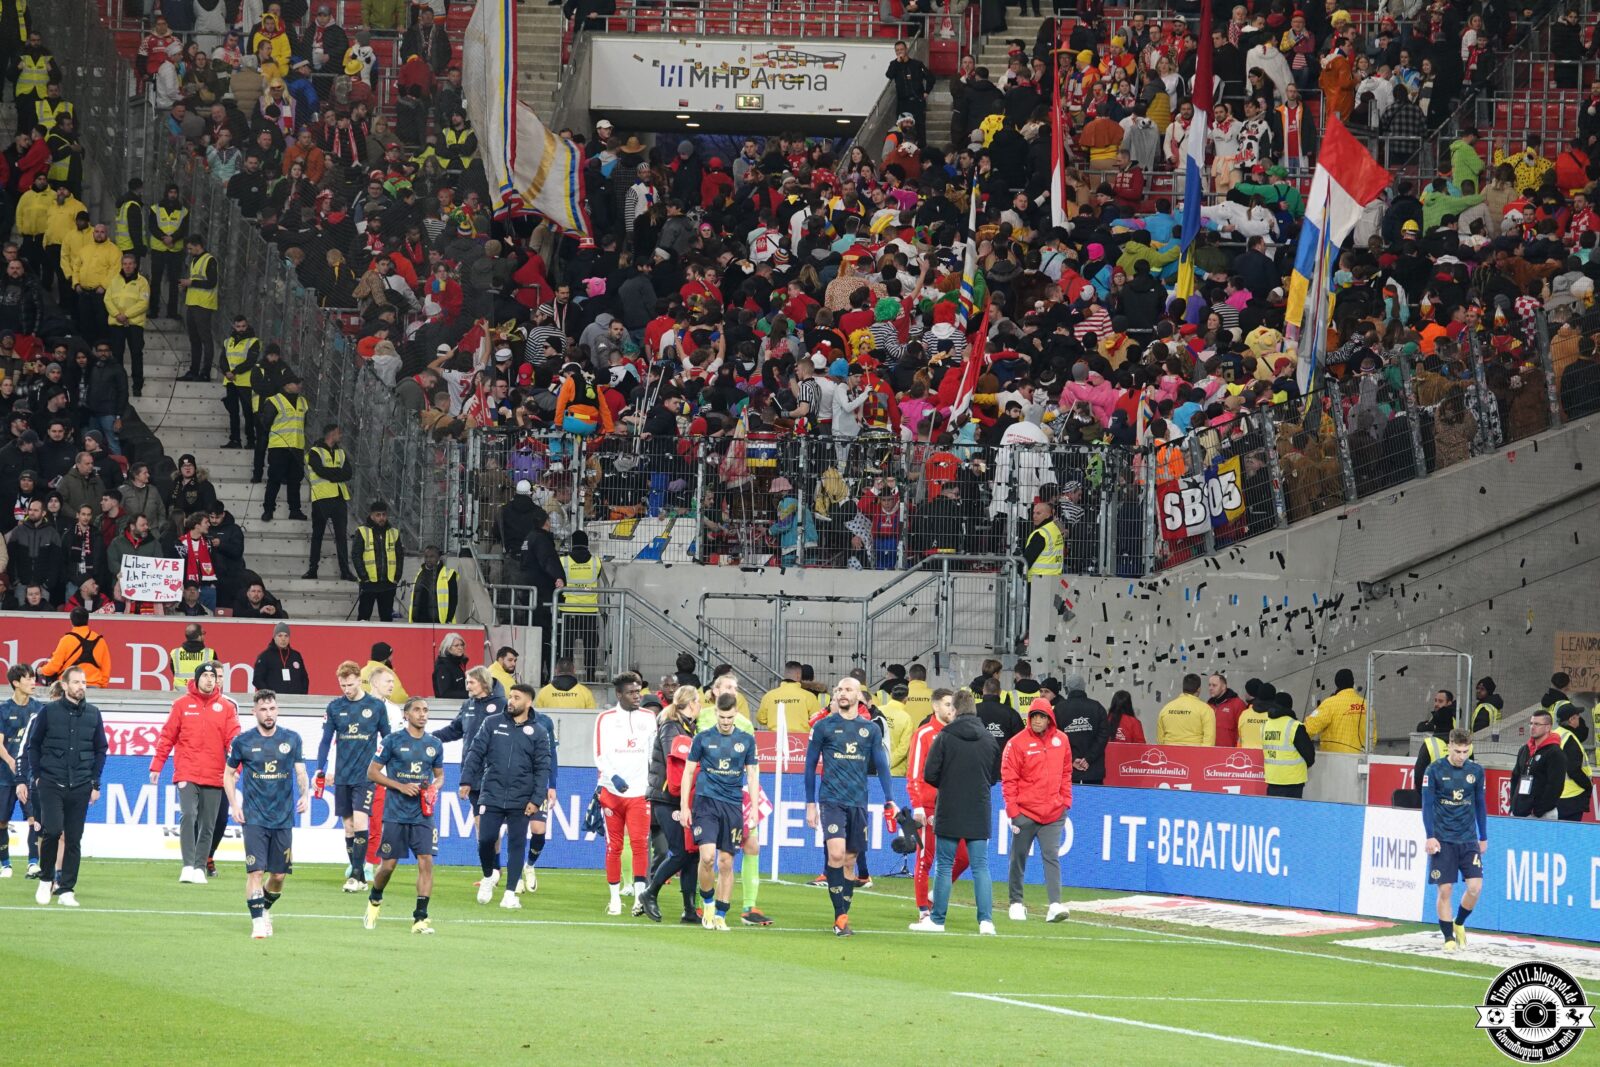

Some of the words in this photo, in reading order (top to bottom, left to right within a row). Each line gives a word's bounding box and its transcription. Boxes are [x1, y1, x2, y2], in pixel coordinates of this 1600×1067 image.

[689, 66, 749, 88] MHP
[752, 67, 828, 91] Arena
[180, 651, 203, 661] SECURITY
[1121, 766, 1187, 777] Schwarzwaldmilch
[730, 828, 742, 843] 14
[1102, 815, 1288, 876] IT-BERATUNG.
[1507, 849, 1573, 906] MHP.
